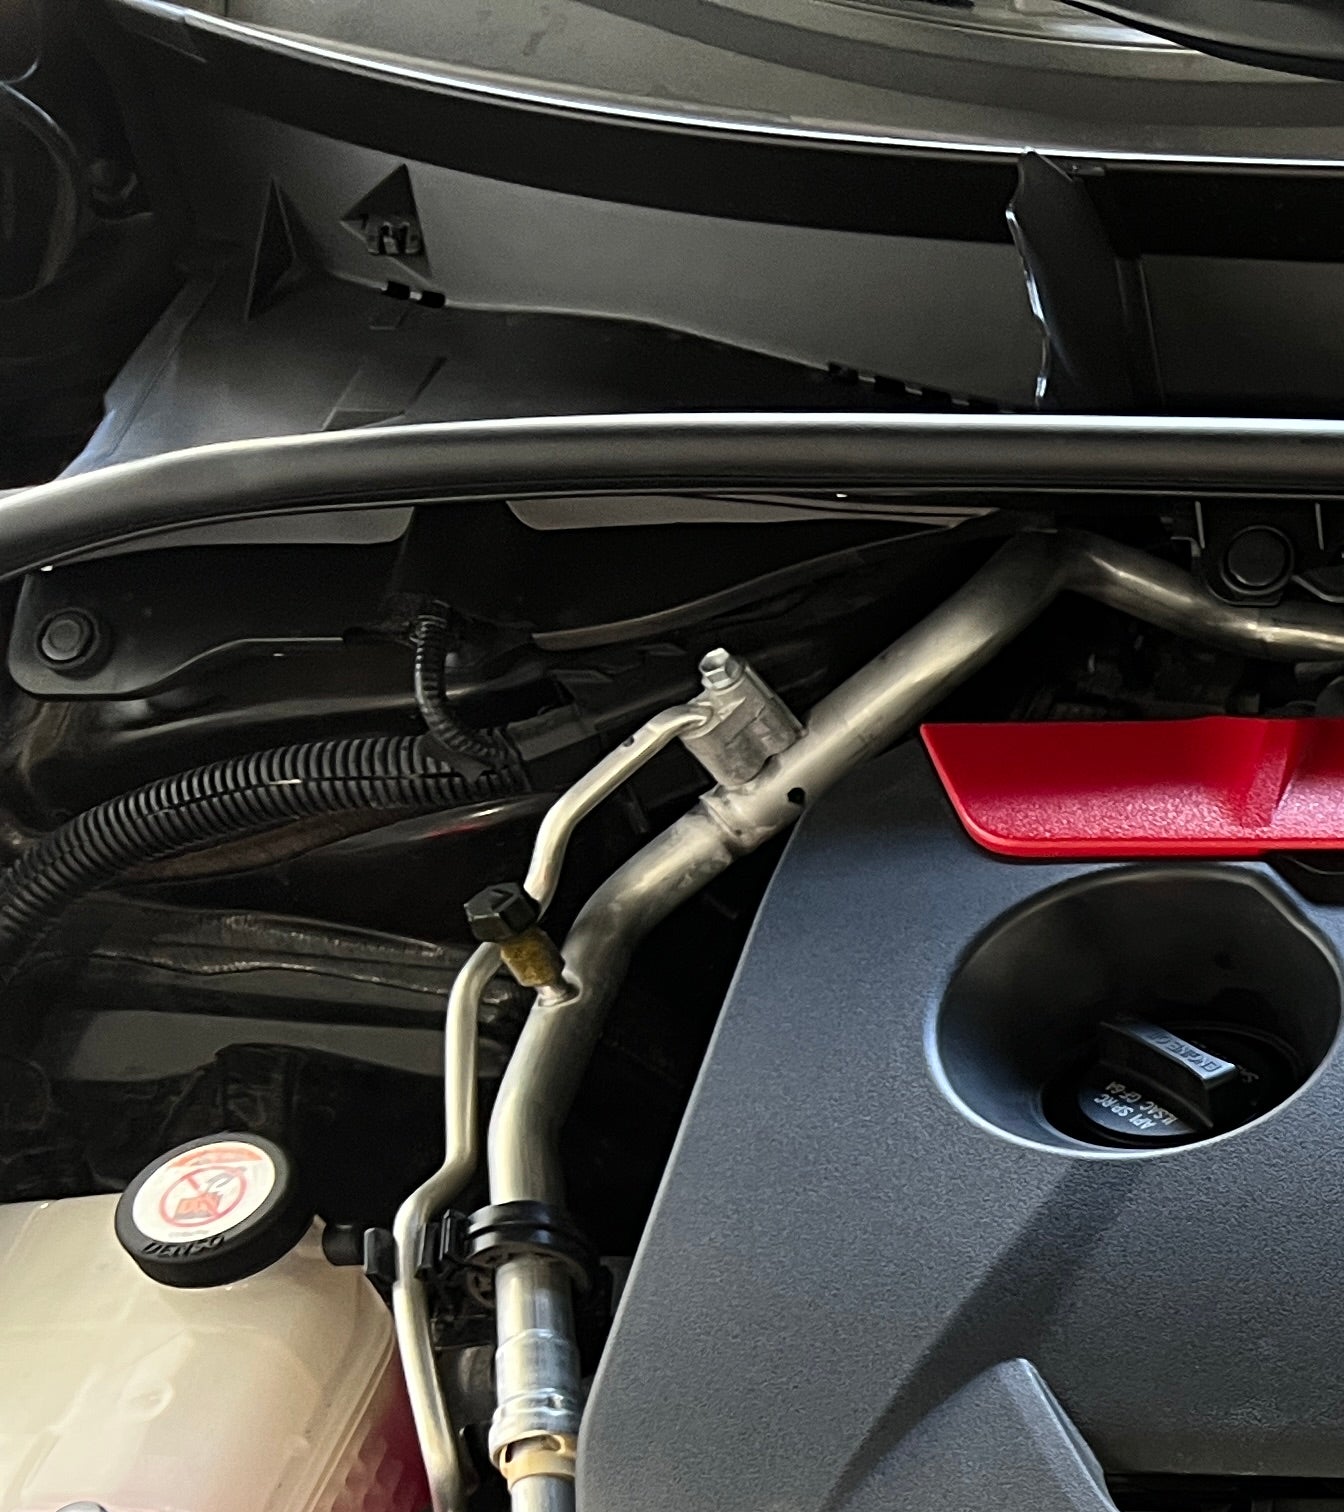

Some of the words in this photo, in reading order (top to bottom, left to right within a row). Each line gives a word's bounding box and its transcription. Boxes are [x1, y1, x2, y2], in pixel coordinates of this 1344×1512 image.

[1129, 1114, 1158, 1129] API
[1140, 1101, 1178, 1126] ILSAC
[142, 1236, 225, 1258] DENSO
